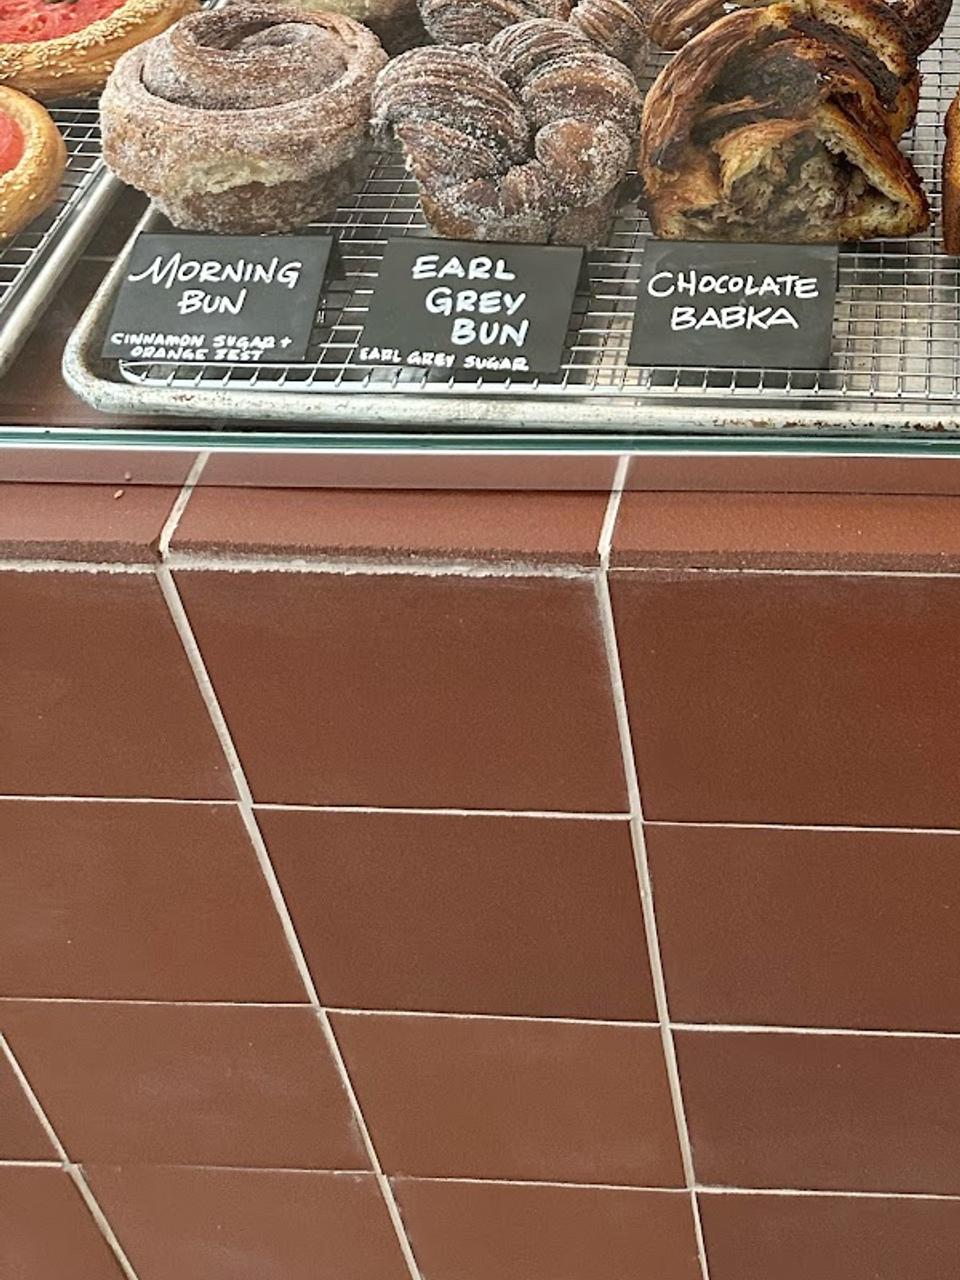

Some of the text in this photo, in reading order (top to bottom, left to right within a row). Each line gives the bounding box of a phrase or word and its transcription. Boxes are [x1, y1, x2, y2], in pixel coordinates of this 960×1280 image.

[126, 251, 302, 290] MORNING
[411, 254, 516, 281] EARL
[647, 270, 819, 299] CHOCOLATE
[176, 288, 247, 315] BUN
[425, 286, 526, 317] GREY
[670, 305, 800, 331] BABKA
[110, 332, 206, 346] CINNAMON
[212, 334, 275, 350] SUGAR
[450, 317, 529, 347] BUN
[130, 346, 209, 360] ORANGE
[359, 347, 530, 371] EARL GREY SUGAR
